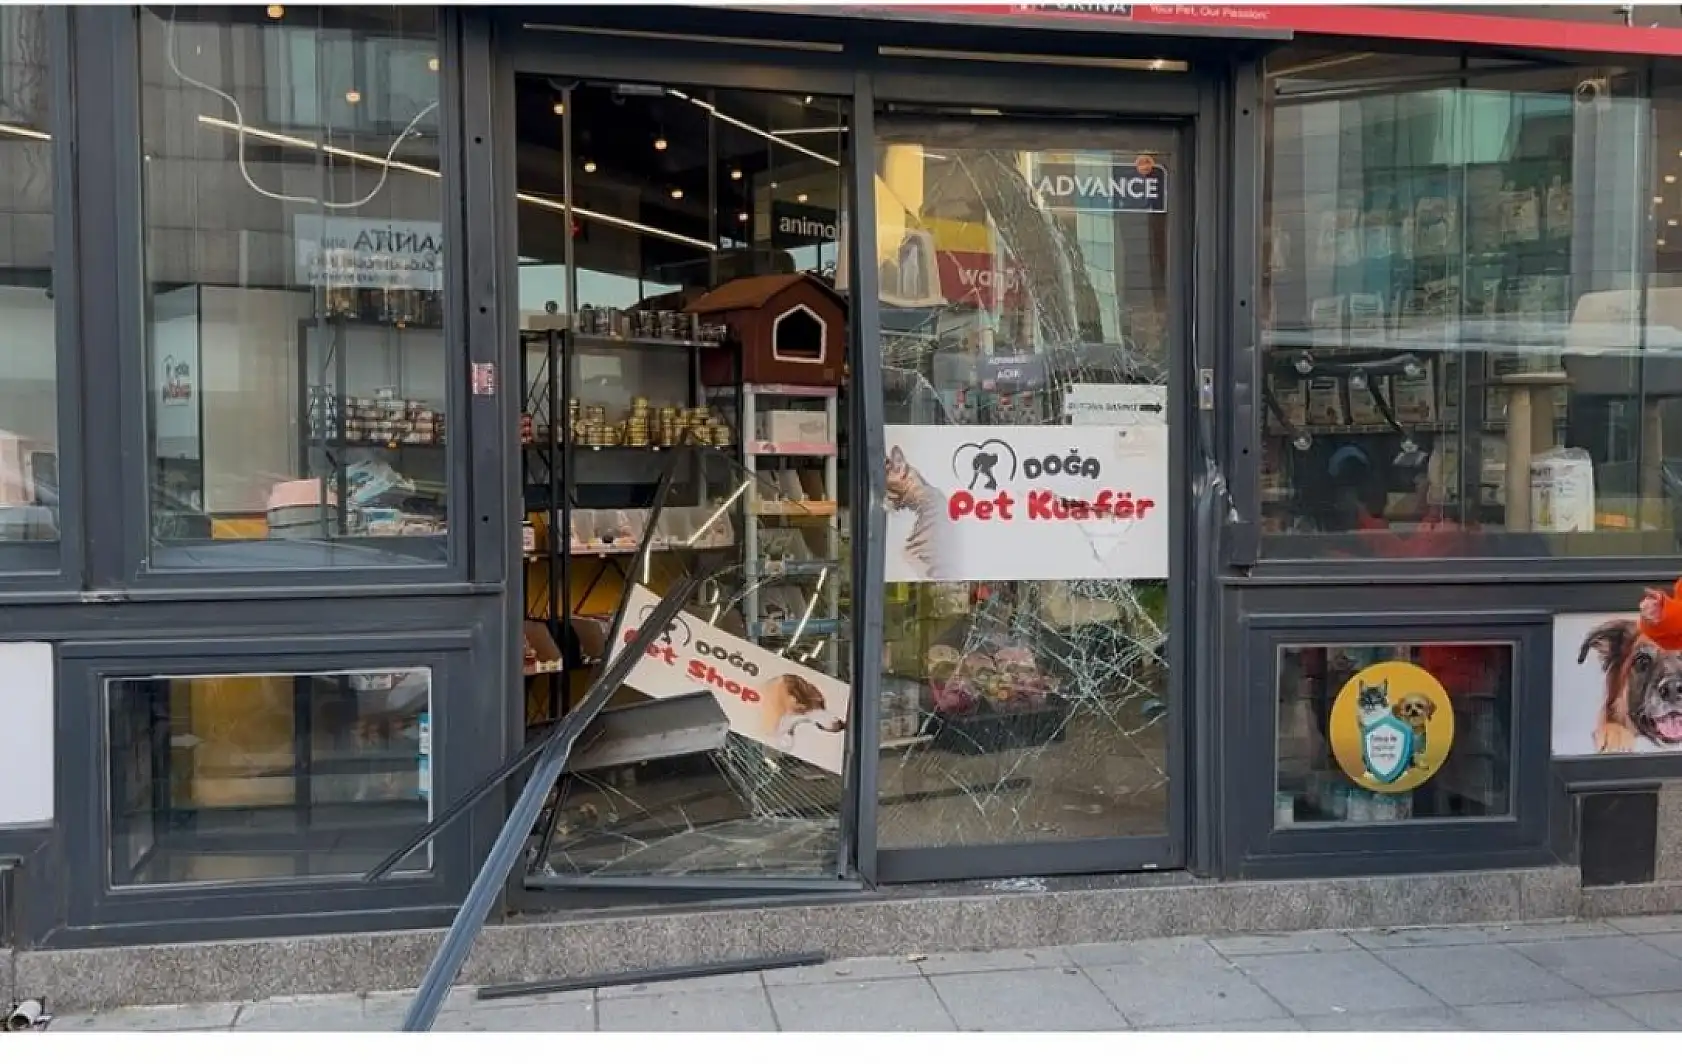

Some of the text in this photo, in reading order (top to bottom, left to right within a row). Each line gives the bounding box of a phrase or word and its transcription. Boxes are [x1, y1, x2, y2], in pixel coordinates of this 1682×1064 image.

[1039, 174, 1160, 199] ADVANCE
[1023, 448, 1101, 480] DOĞA
[948, 490, 1155, 521] Pet Kuaför
[687, 660, 761, 702] Shop
